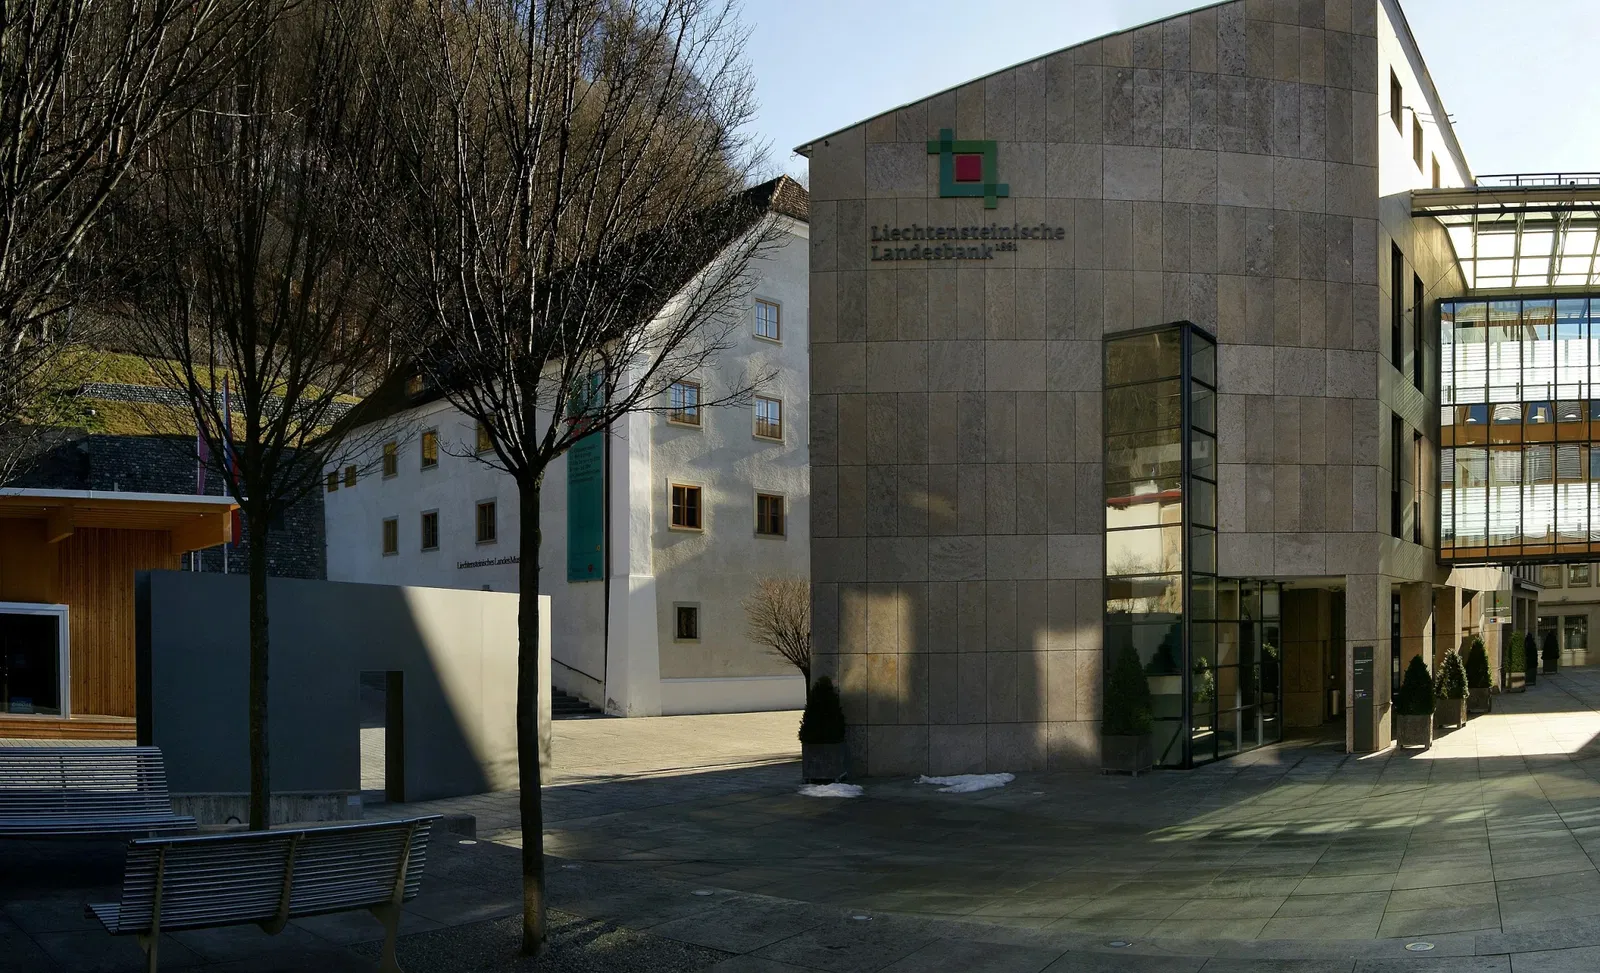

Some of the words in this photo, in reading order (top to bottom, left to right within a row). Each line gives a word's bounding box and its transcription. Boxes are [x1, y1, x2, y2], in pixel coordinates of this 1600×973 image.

[871, 223, 1065, 240] Liechtensteinische
[871, 243, 993, 260] Landesbank
[995, 241, 1017, 251] 1861
